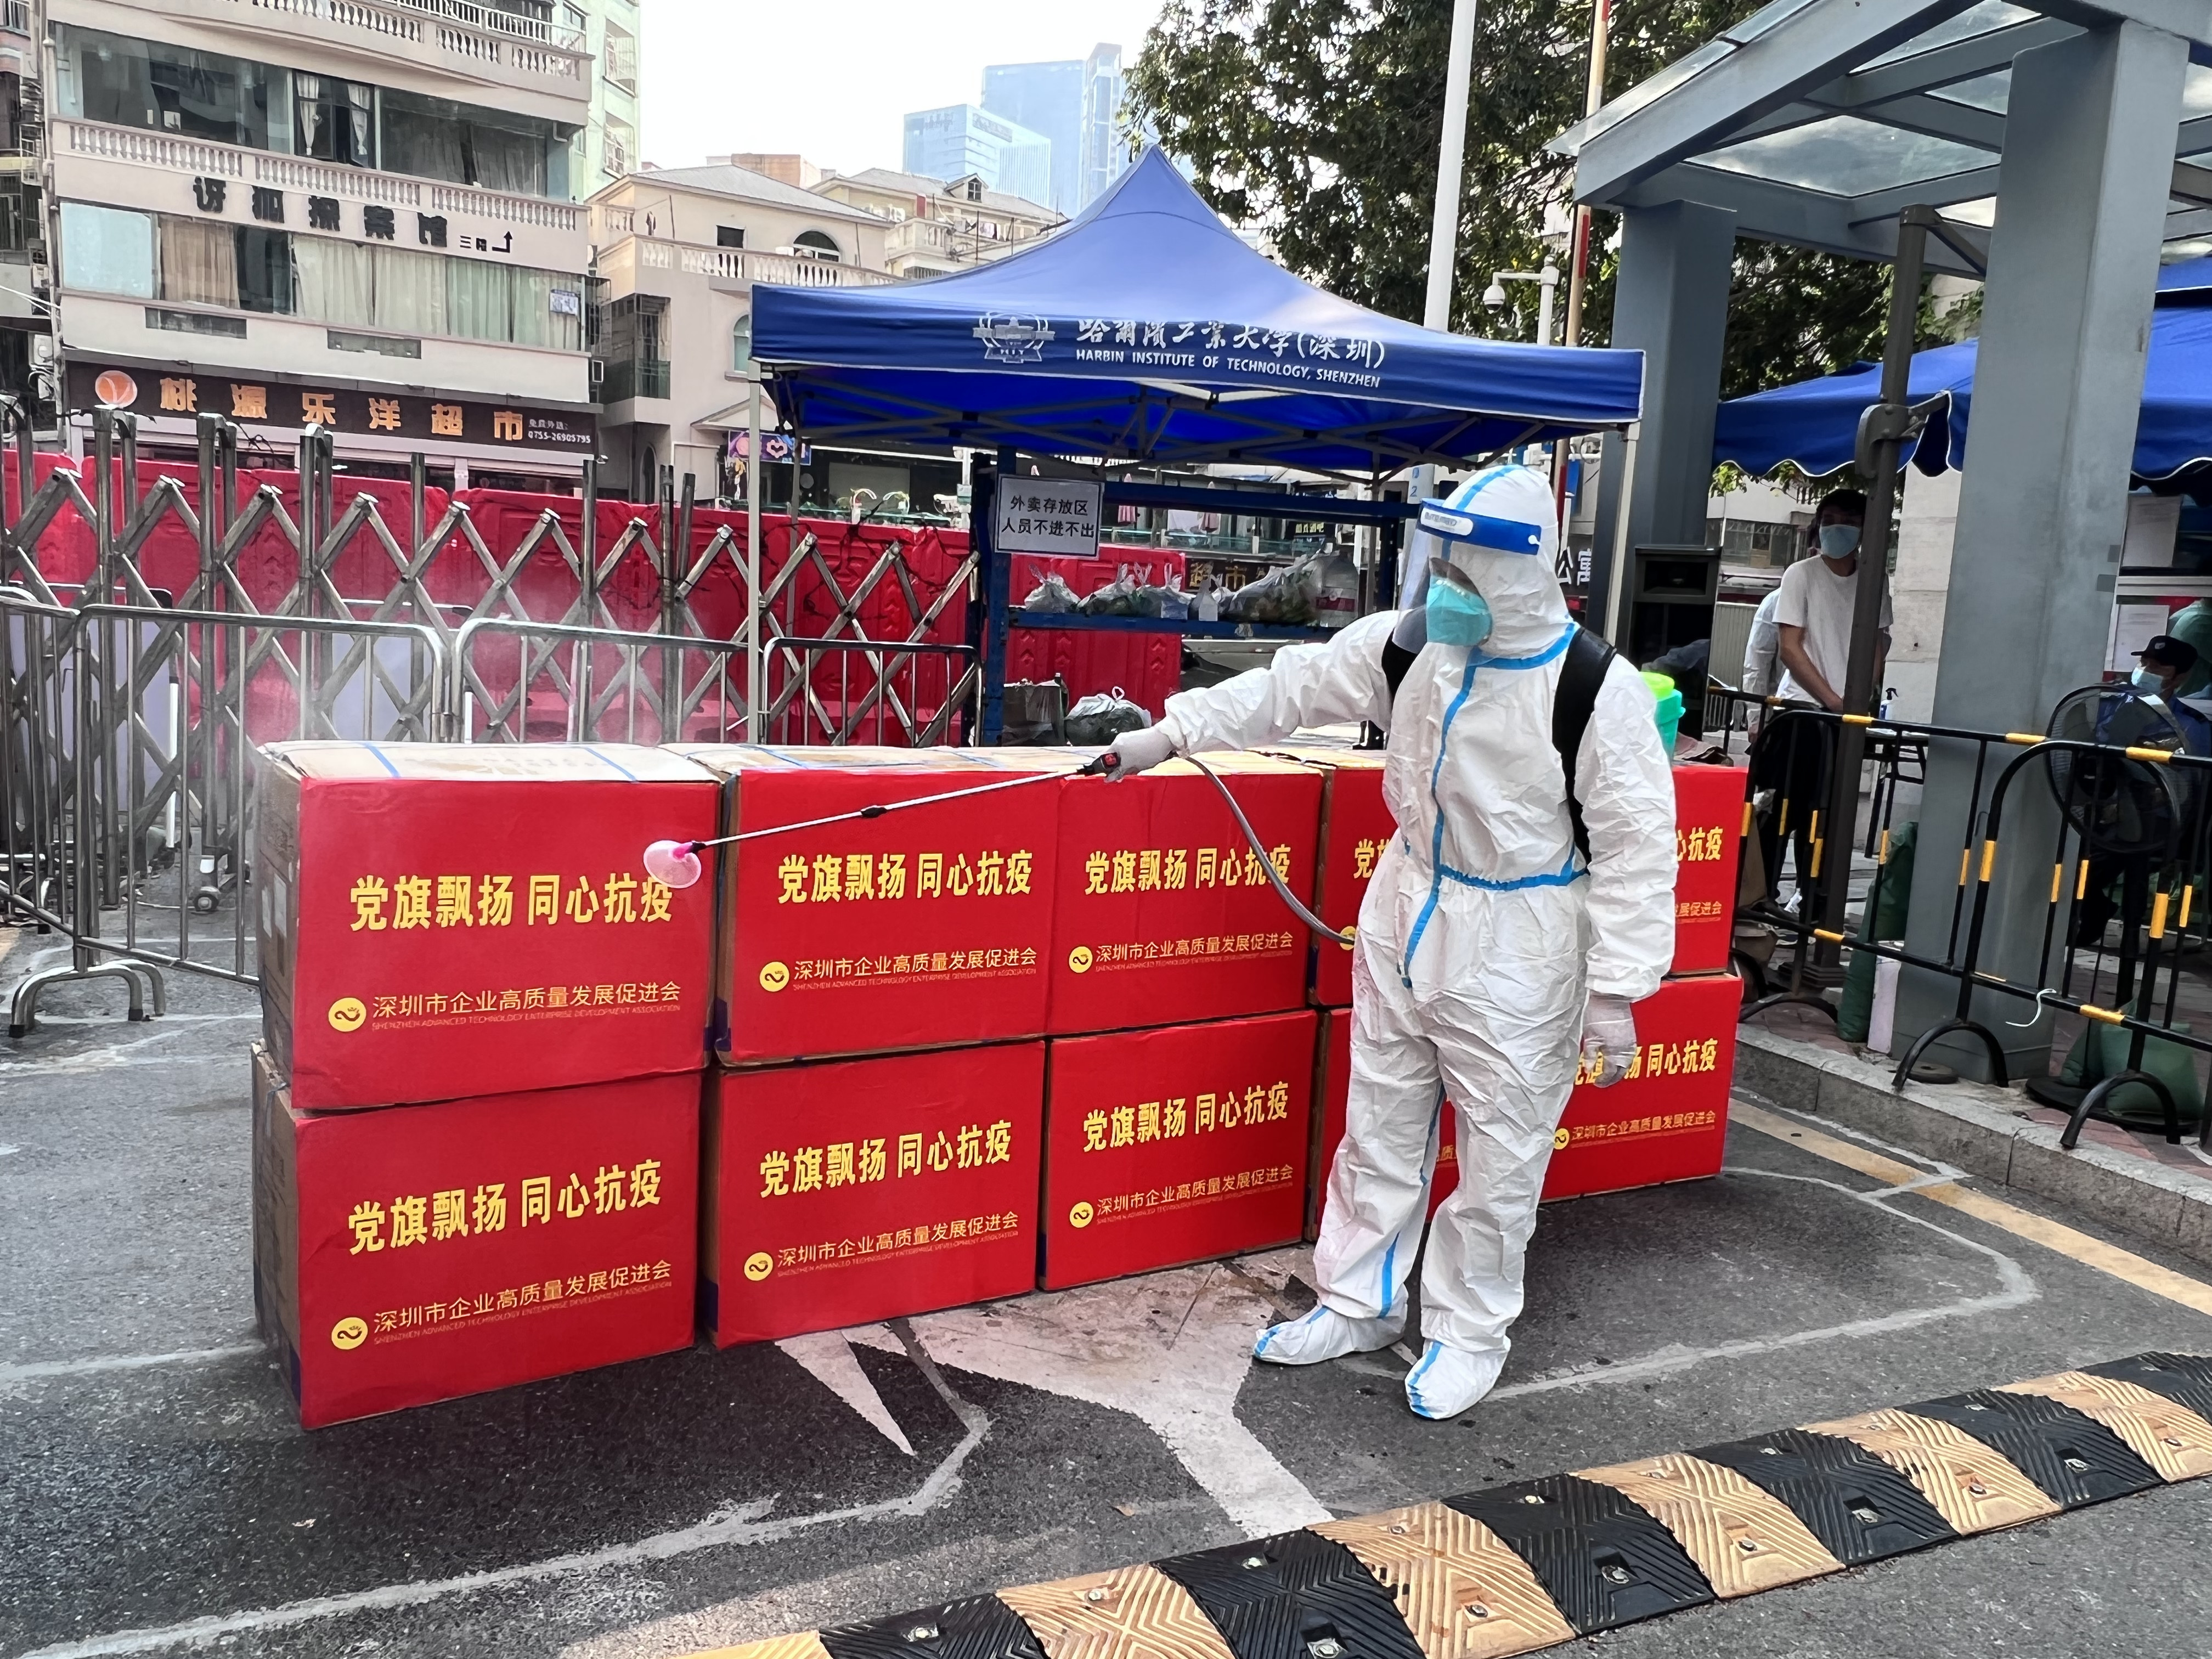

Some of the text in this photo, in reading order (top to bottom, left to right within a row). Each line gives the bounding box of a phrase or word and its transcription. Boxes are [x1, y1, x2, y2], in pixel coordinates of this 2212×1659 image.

[1076, 349, 1381, 388] HARBIN INSTITUTE OF TECHNOLOGY, SHENZHEN
[1001, 517, 1094, 538] 人员不进不出
[1010, 495, 1088, 516] 外卖存放区
[778, 849, 1033, 904] 党旗飘扬 同心抗疫
[1085, 844, 1291, 895] 党旗飘扬 同心抗疫
[351, 873, 673, 932] 党旗飘扬 同心抗疫
[794, 947, 1037, 980] 深圳市企业高质量发展促进会
[1096, 931, 1294, 963] 深圳市企业高质量发展促进会
[373, 981, 681, 1018] 深圳市企业高质量发展促进会
[1646, 1037, 1719, 1077] 同心抗疫
[1083, 1081, 1289, 1153] 党旗飘扬 同心抗疫
[760, 1120, 1012, 1198] 党旗飘扬 同心抗疫
[349, 1159, 662, 1256] 党旗飘扬 同心抗疫
[1097, 1164, 1293, 1216] 深圳市企业高质量发展促进会
[777, 1210, 1019, 1268] 深圳市企业高质量发展促进会
[374, 1259, 672, 1334] 深圳市企业高质量发展促进会
